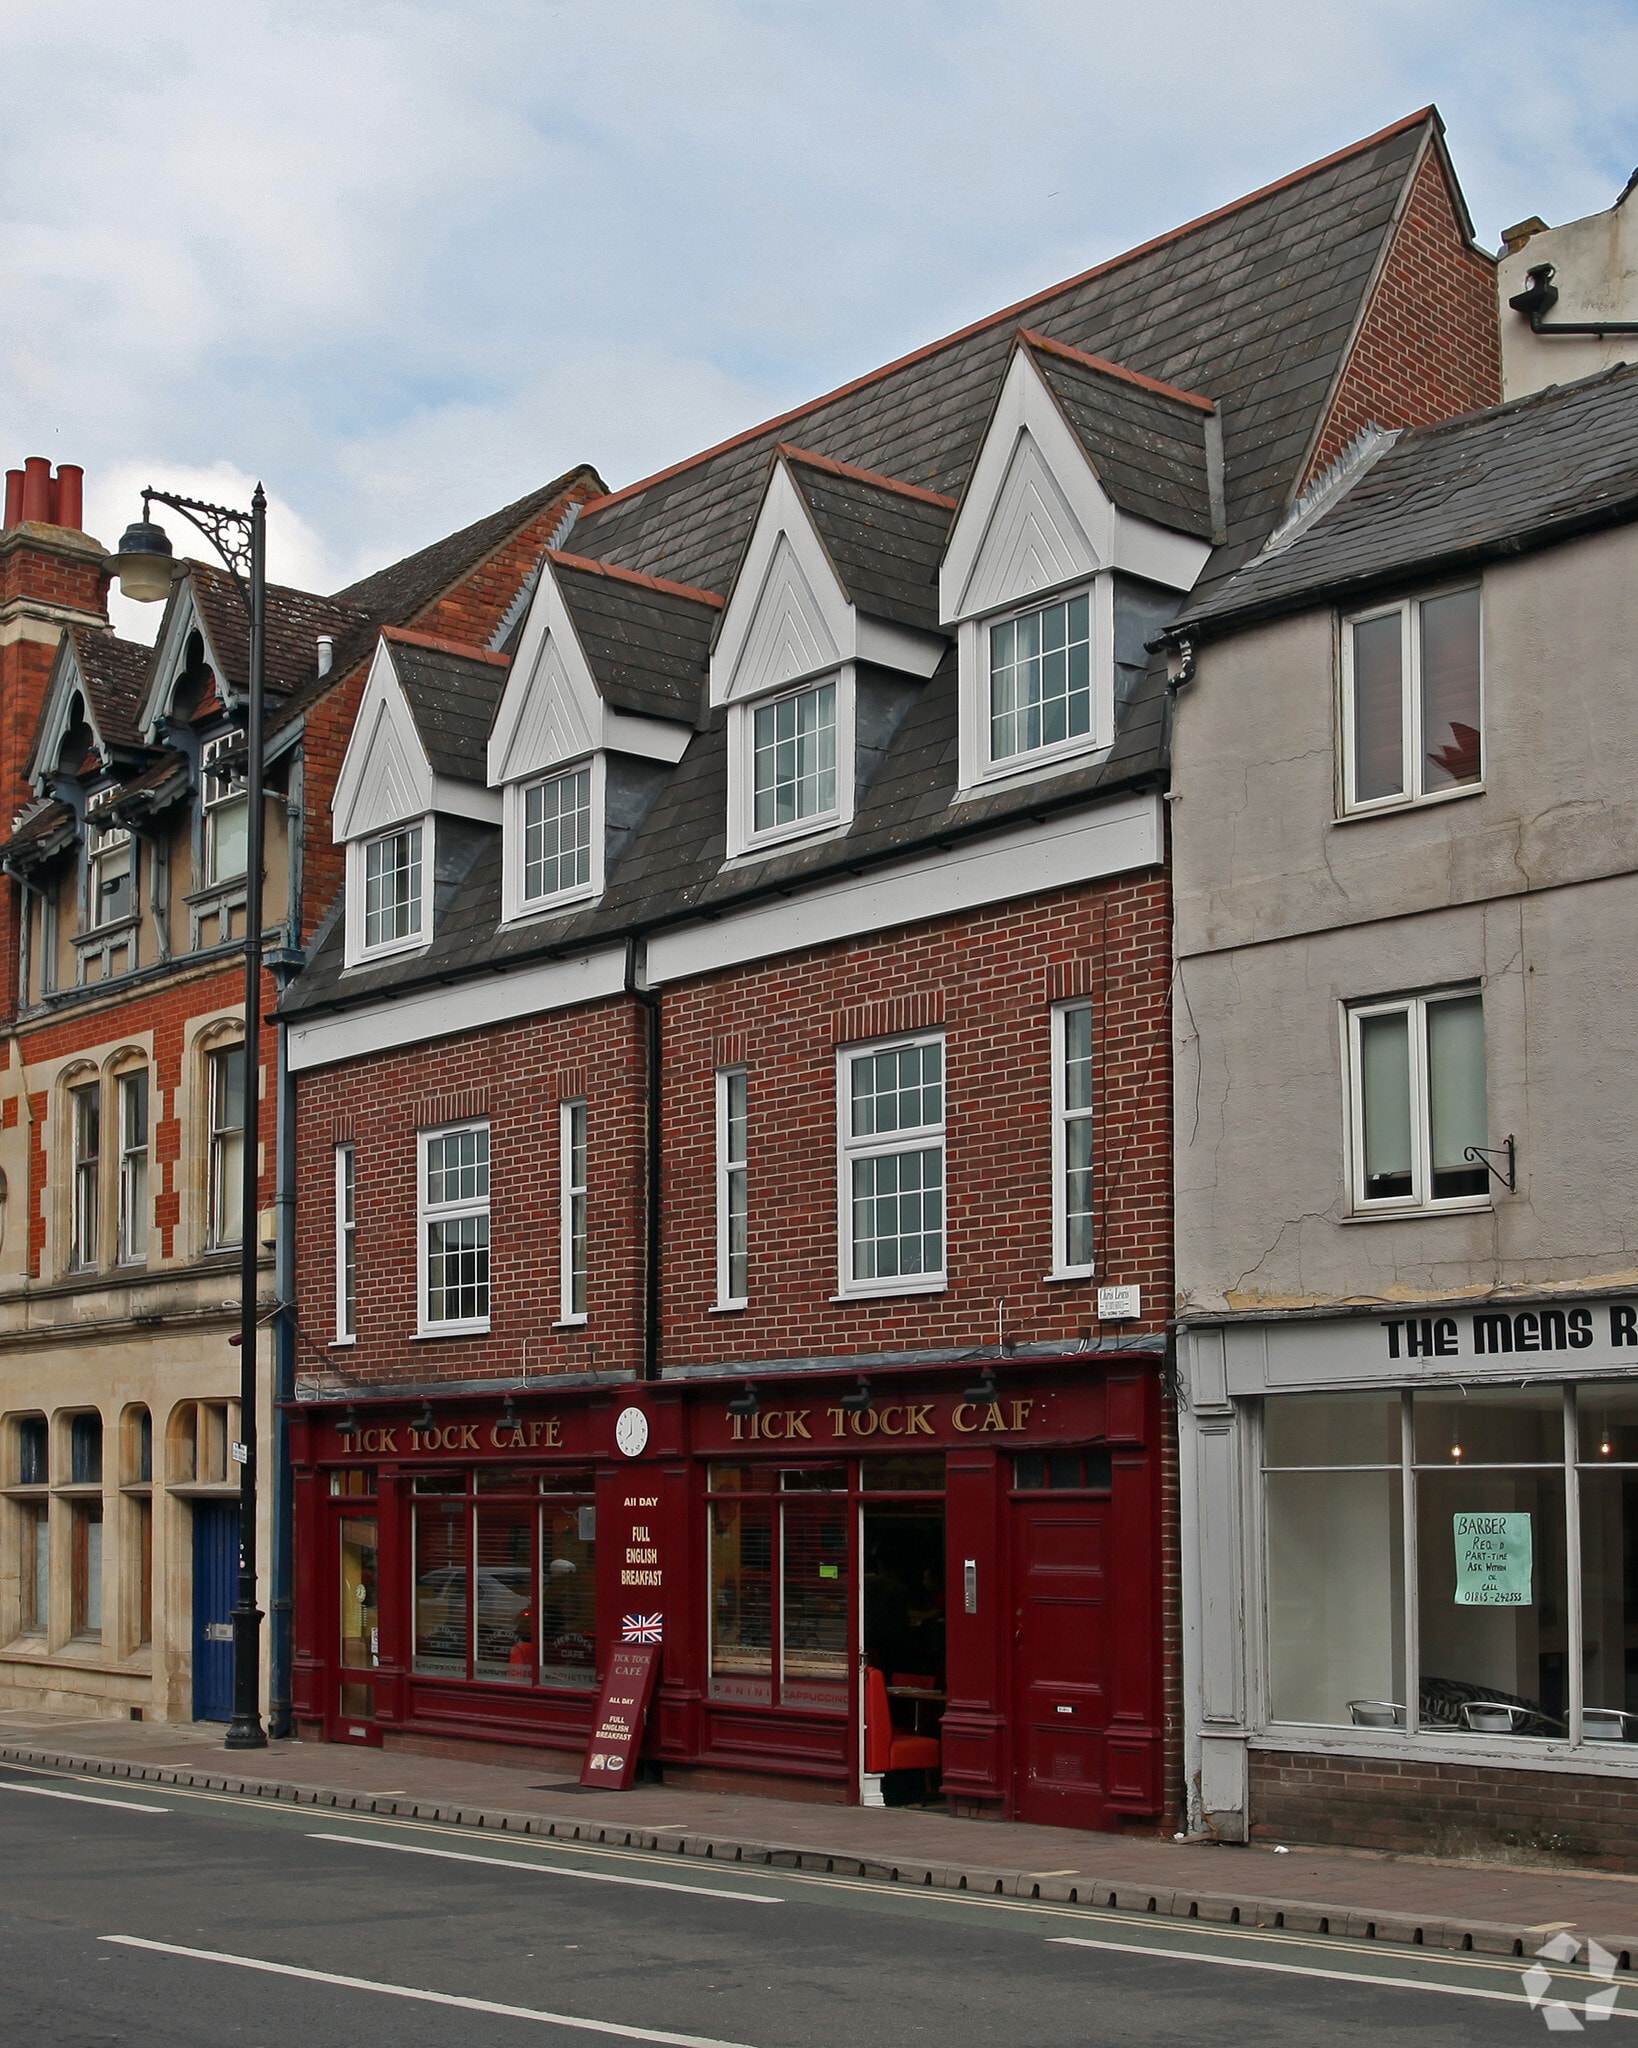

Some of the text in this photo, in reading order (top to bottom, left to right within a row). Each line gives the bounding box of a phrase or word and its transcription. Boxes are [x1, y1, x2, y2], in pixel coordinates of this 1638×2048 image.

[1381, 1317, 1458, 1358] THE
[726, 1398, 1034, 1440] TICK TOCK CAF
[338, 1416, 563, 1453] TICK TOCK CAFÉ
[639, 1497, 659, 1507] DAY
[1458, 1516, 1507, 1535] BARBER
[632, 1526, 651, 1542] FULL
[626, 1548, 657, 1564] ENGLISH
[1465, 1550, 1508, 1561] PART-TIME
[1467, 1562, 1483, 1572] ASK
[621, 1570, 662, 1586] BREAKFAST
[560, 1650, 585, 1659] CAFE
[613, 1653, 651, 1665] TICK TOCK
[615, 1666, 643, 1677] CAFÉ
[714, 1685, 770, 1697] PANINI
[609, 1715, 625, 1724] FULL
[601, 1723, 630, 1732] ENGLISH
[595, 1731, 632, 1741] BREAKFAST
